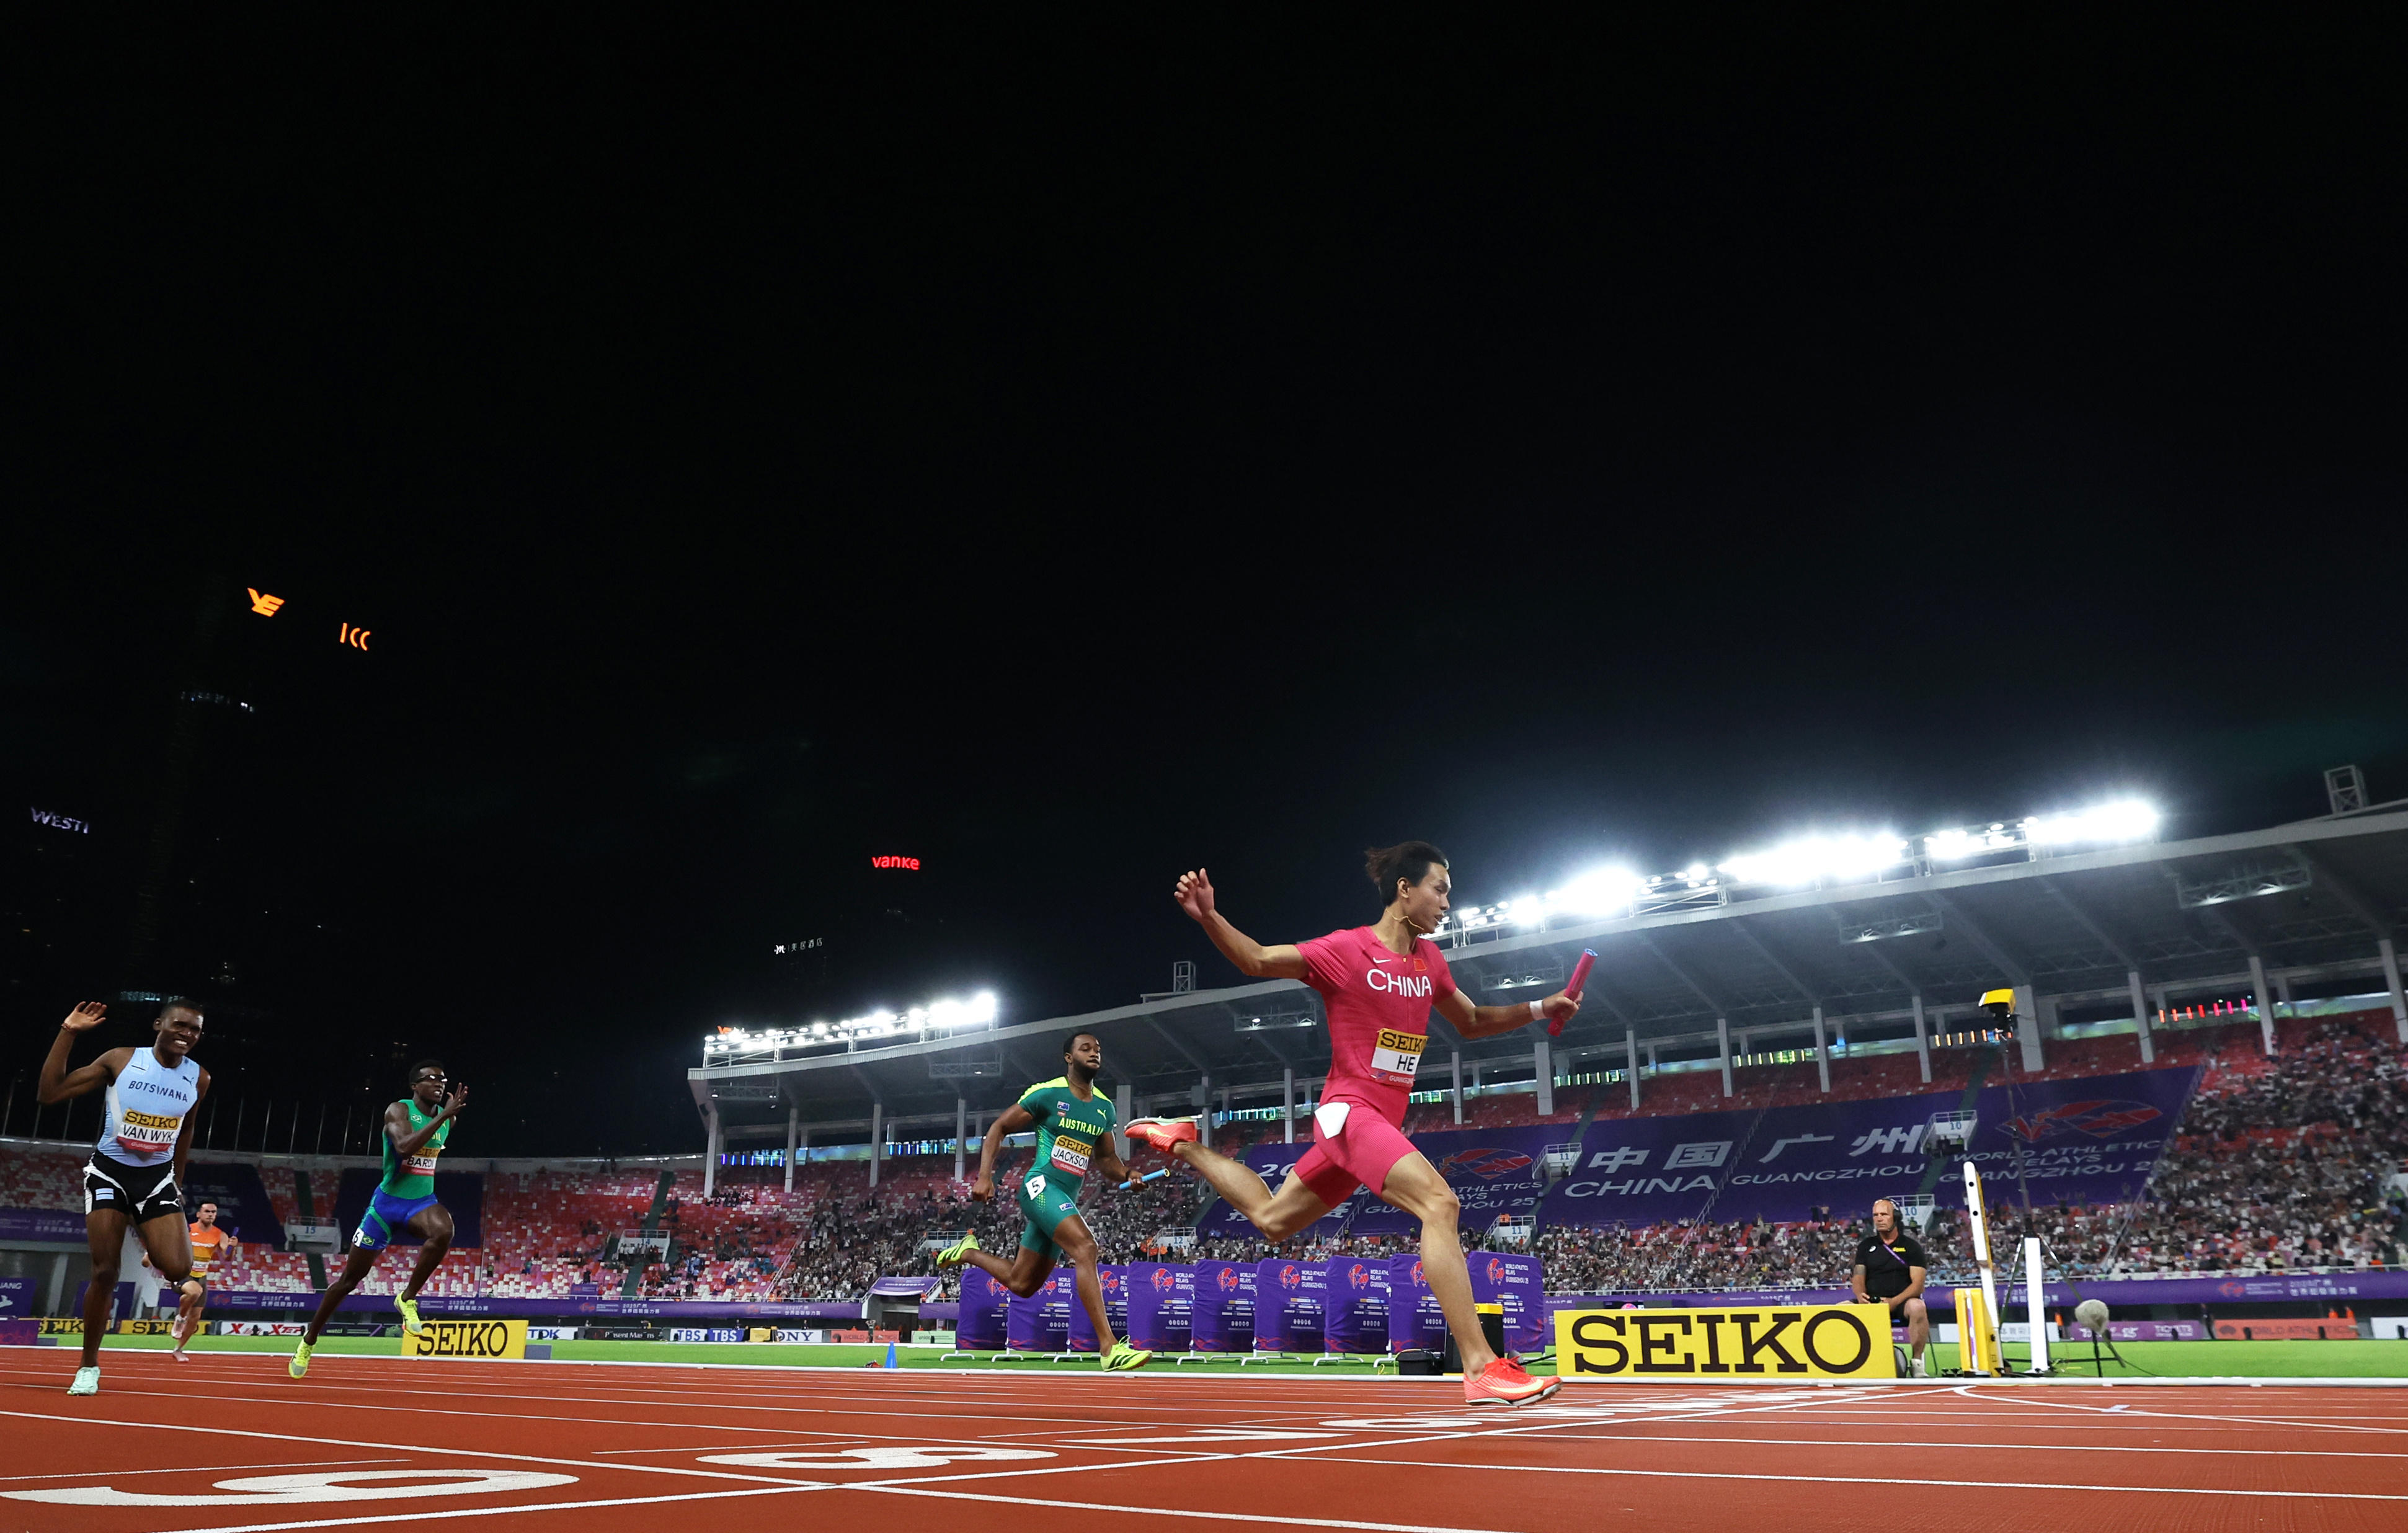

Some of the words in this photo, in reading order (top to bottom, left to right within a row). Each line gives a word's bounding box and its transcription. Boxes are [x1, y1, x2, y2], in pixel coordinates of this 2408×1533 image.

[871, 855, 920, 870] vanke
[1366, 969, 1433, 997] CHINA
[1380, 1031, 1427, 1052] SEIK
[1397, 1054, 1416, 1072] HE
[128, 1080, 188, 1103] BOTSWANA
[125, 1111, 178, 1129] SEIKO
[1950, 1121, 1961, 1130] 10
[123, 1124, 148, 1140] VAN
[151, 1129, 175, 1142] WYK
[1588, 1141, 1733, 1173] 中国
[1759, 1124, 1924, 1163] 广州
[1953, 1150, 2035, 1163] WORLD
[2041, 1140, 2161, 1157] ATHLETIC
[407, 1157, 434, 1168] BARDI
[1053, 1148, 1088, 1168] JACKSON
[2009, 1154, 2102, 1168] RELAYS
[1939, 1163, 2125, 1182] GANGZHOU
[2133, 1161, 2154, 1172] 2
[1031, 1180, 1040, 1194] 5
[1565, 1175, 1717, 1198] CHINA
[1731, 1163, 1925, 1185] GUANGZHOU
[1510, 1198, 1537, 1206] 25
[1904, 1207, 1917, 1215] 10
[305, 1226, 316, 1234] 15
[353, 1232, 360, 1246] 6
[943, 1240, 951, 1248] 13
[416, 1322, 509, 1357] SEIKO
[528, 1329, 560, 1339] TDK
[677, 1330, 701, 1341] TBS
[713, 1330, 737, 1341] TBS
[777, 1331, 813, 1341] ONY
[1571, 1310, 1872, 1374] SEIKO
[1054, 1429, 1354, 1444] 7
[693, 1446, 1058, 1469] 8
[0, 1469, 580, 1506] 9
